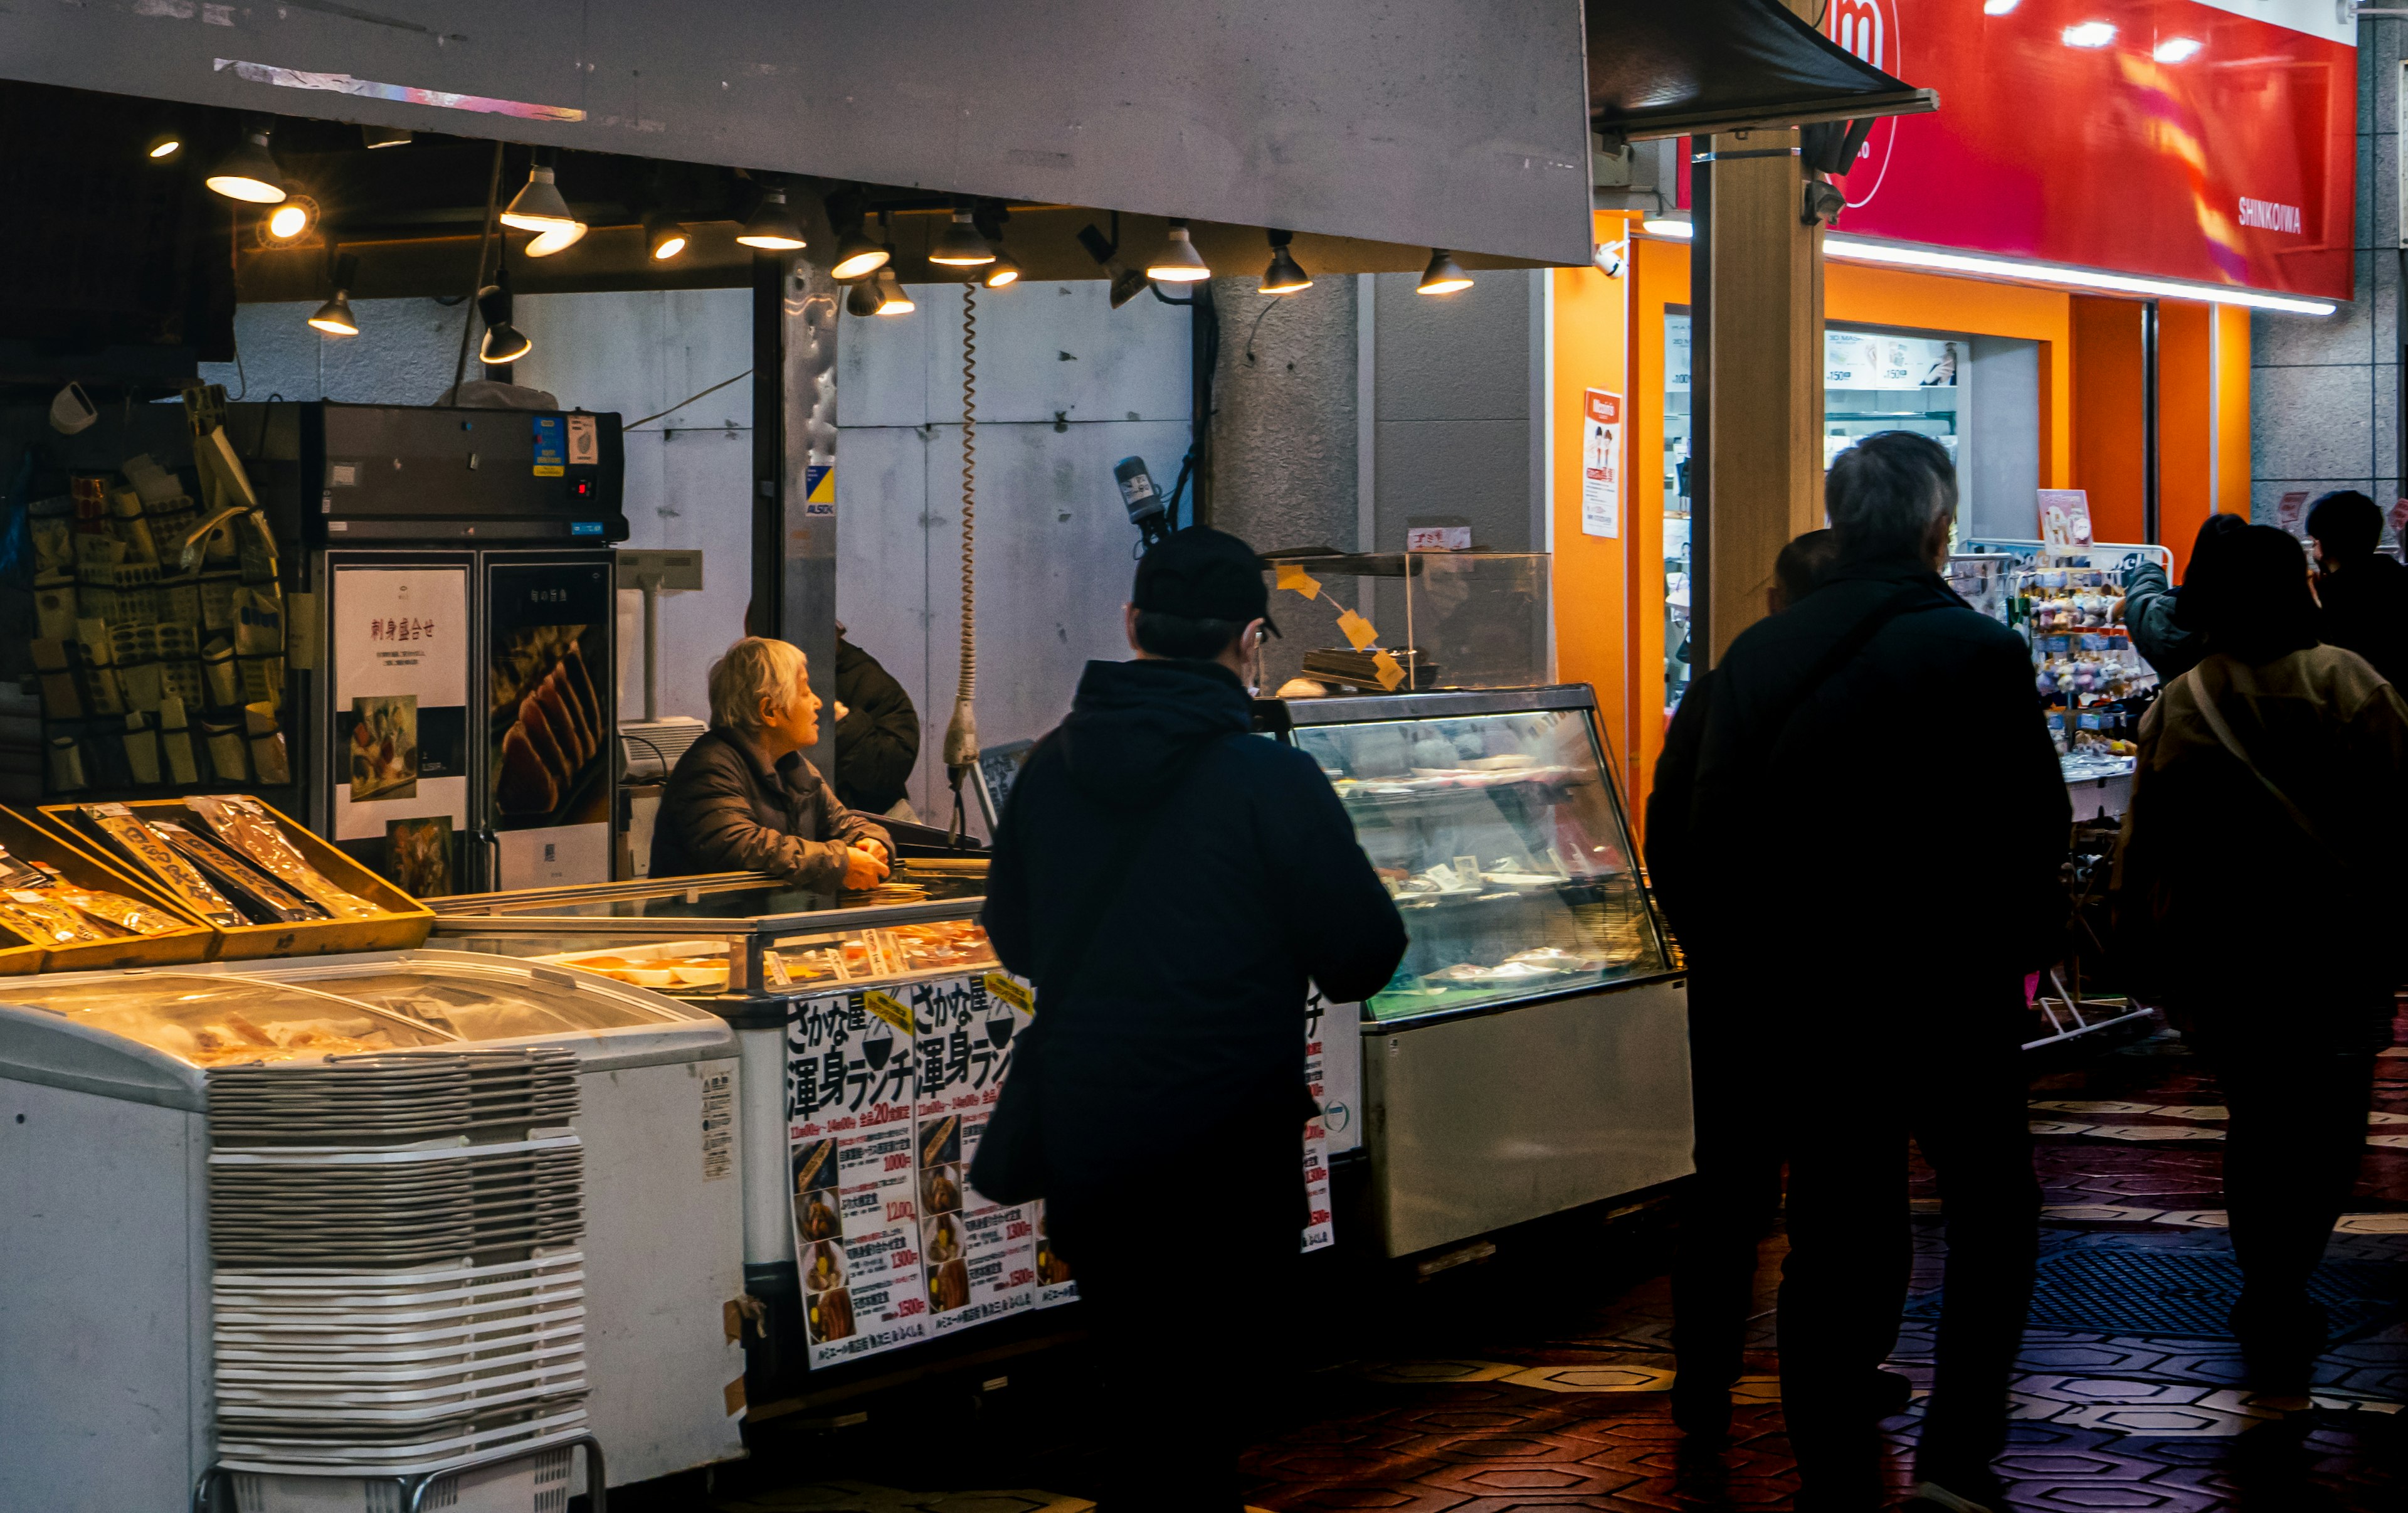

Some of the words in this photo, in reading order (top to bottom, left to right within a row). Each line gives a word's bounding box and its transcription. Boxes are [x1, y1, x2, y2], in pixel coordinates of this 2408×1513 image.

[2239, 196, 2301, 234] SHINKOIWA
[371, 617, 435, 641] 刺身盛合せ
[787, 993, 866, 1054] さかな屋
[912, 976, 989, 1034] さかな屋
[788, 1045, 914, 1122] 渾身ランチ
[915, 1024, 1011, 1100] 渾身ラン
